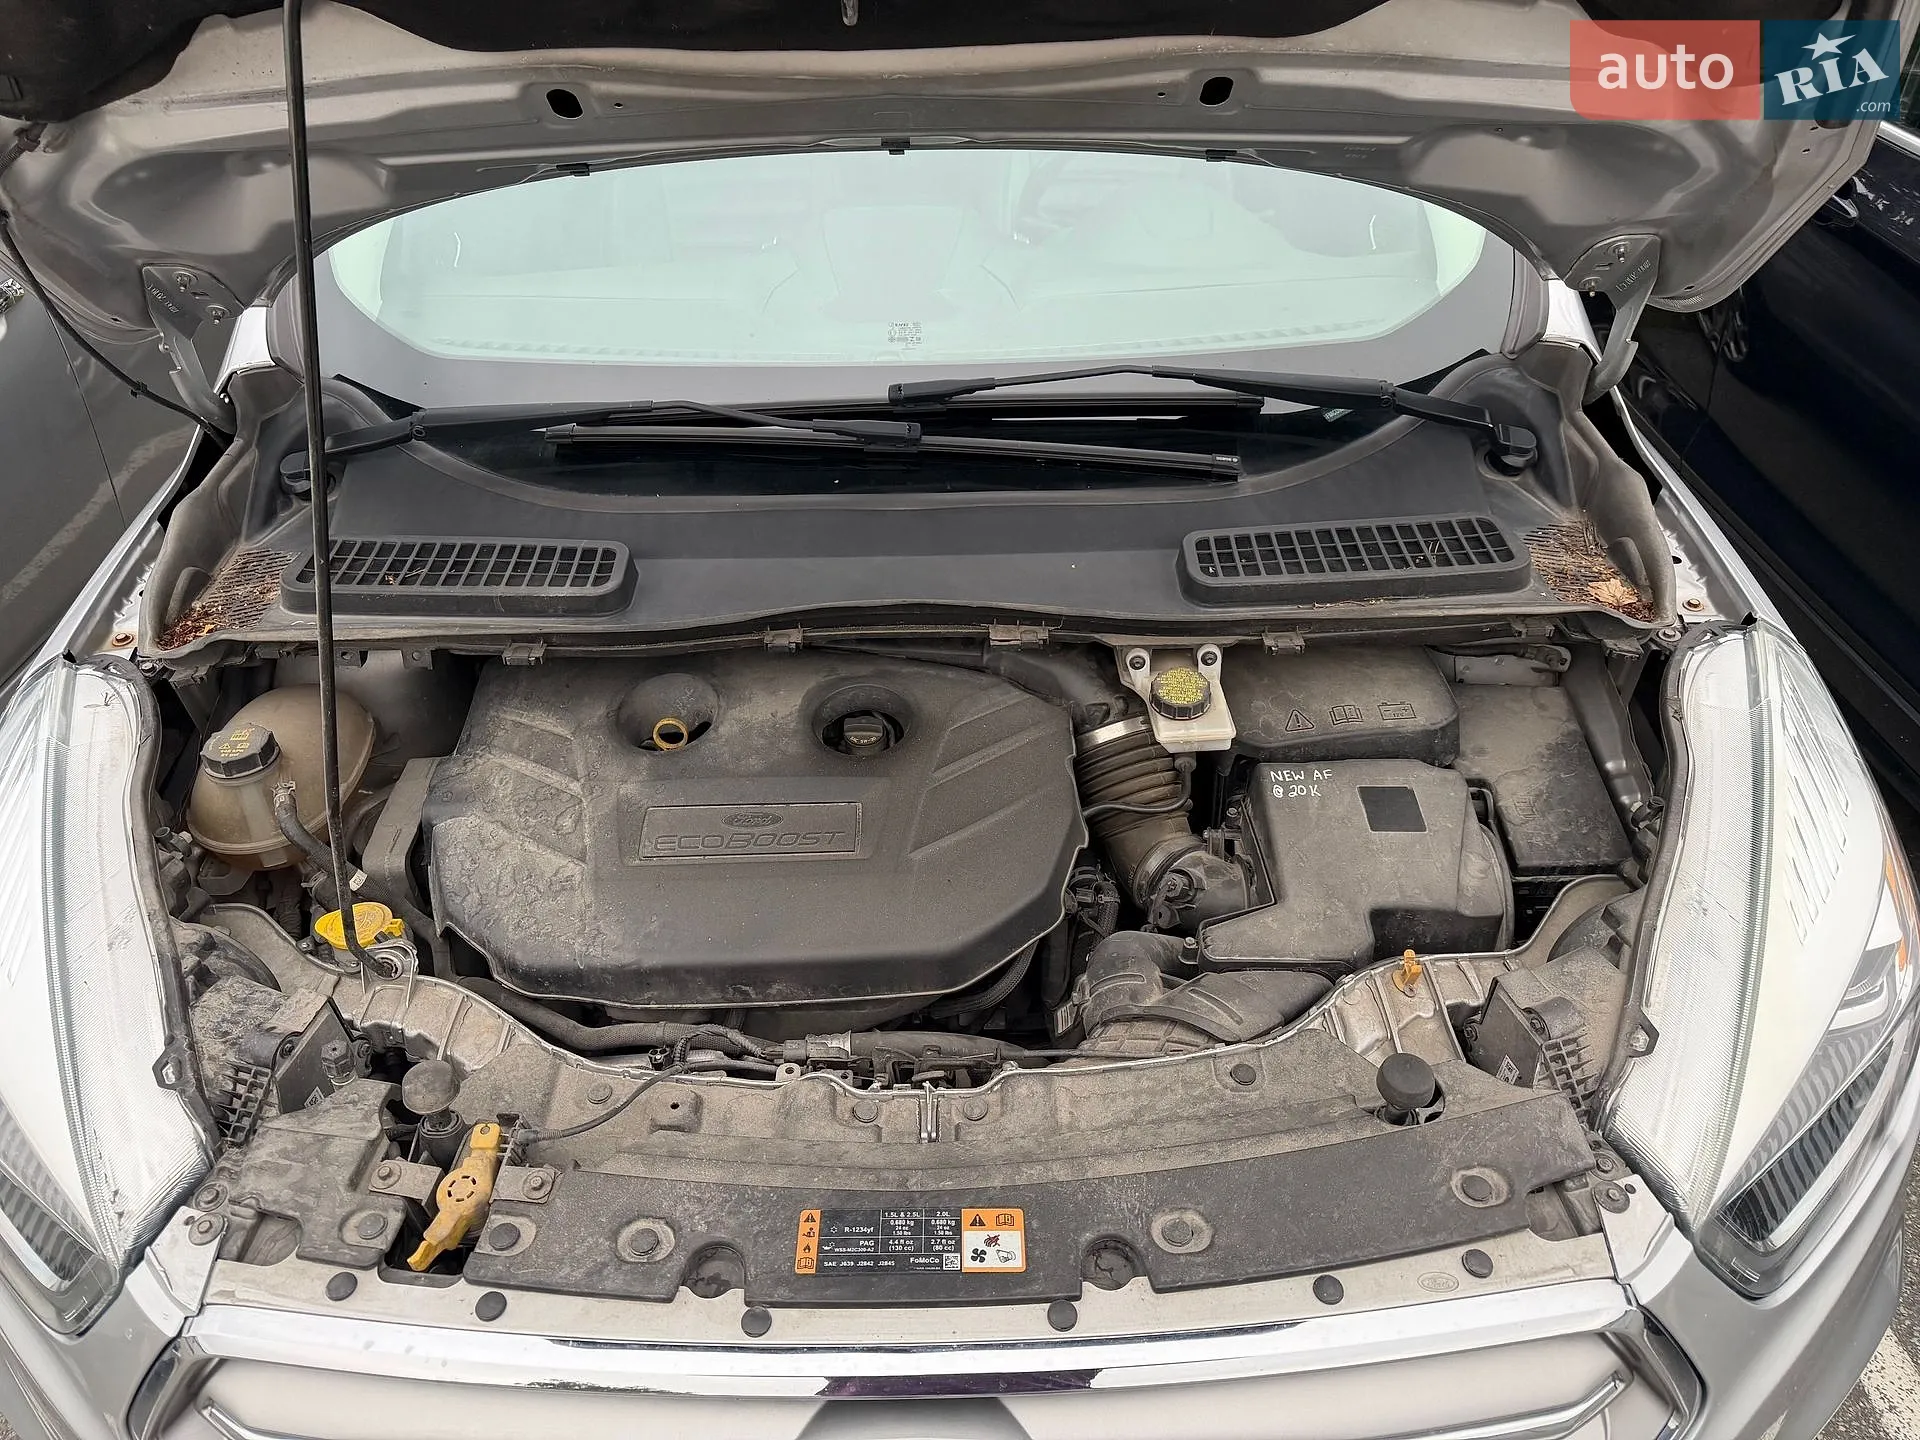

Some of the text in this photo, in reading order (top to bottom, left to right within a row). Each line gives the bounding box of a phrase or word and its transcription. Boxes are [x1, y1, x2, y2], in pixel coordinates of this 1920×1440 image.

[1270, 769, 1333, 782] NEW AF
[654, 831, 845, 851] ECOBOOST
[907, 1219, 915, 1227] kg
[948, 1219, 956, 1227] kg
[844, 1226, 874, 1234] R-1234yf
[910, 1256, 940, 1264] FoMoCo
